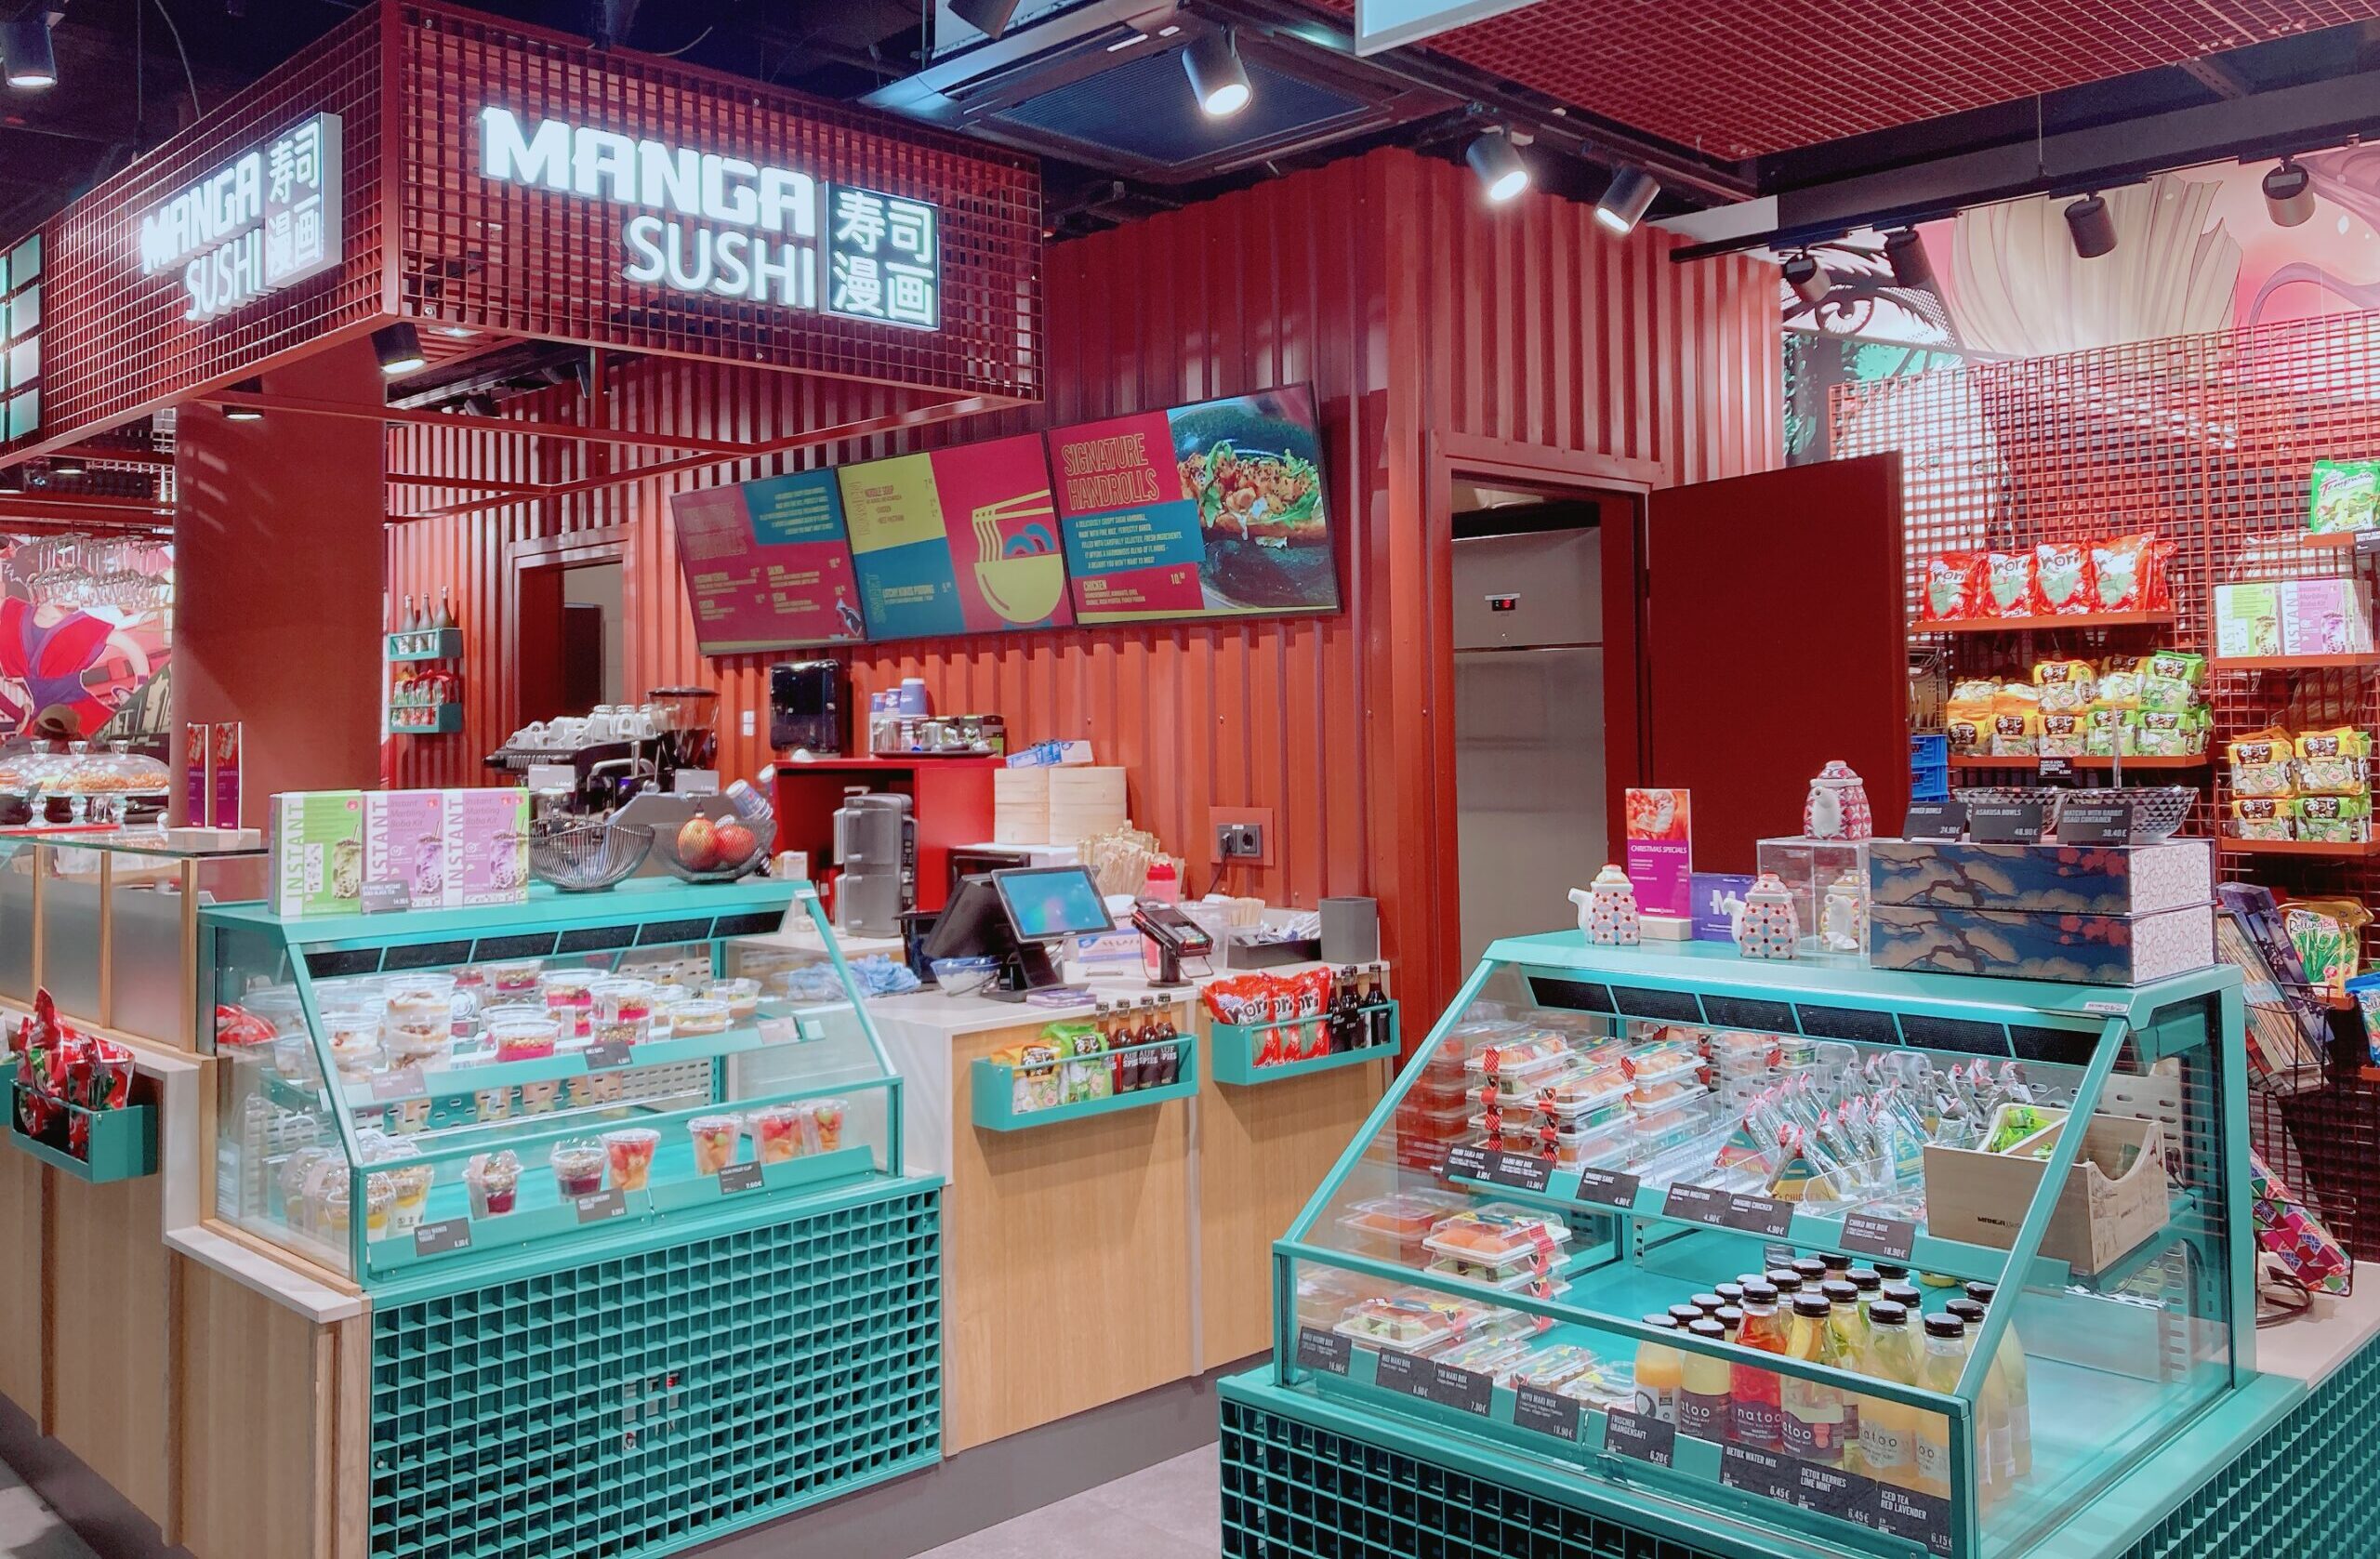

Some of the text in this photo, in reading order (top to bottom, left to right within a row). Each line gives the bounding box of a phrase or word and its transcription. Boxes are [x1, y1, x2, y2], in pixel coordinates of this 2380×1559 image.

[269, 122, 321, 204] 寿司
[481, 106, 816, 238] MANGA
[140, 152, 262, 275] MANGA
[838, 190, 932, 263] 寿司
[268, 193, 324, 279] 漫画
[626, 215, 815, 310] SUSHI
[185, 228, 263, 322] SUSHI
[833, 251, 935, 324] 漫画
[1062, 432, 1149, 477] SIGNATURE
[1066, 468, 1161, 511] HANDROLLS
[2285, 588, 2301, 655] INSTANT
[466, 808, 500, 816] Marbling
[2002, 808, 2022, 816] BOWLS
[2063, 809, 2087, 817] MATCHA
[2080, 815, 2112, 824] CONTAINER
[285, 802, 304, 899] INSTANT
[372, 800, 388, 883] NSTANT
[447, 799, 464, 891] INSTANT
[1631, 845, 1687, 854] CHRISTMAS SPECIALS
[2289, 918, 2323, 933] Rolling
[1601, 1173, 1615, 1183] SAKE
[1752, 1201, 1774, 1212] CHICKEN
[1703, 1213, 1720, 1224] 4.90€
[1865, 1221, 1876, 1230] MIX
[1876, 1222, 1889, 1233] BOX
[1765, 1224, 1785, 1235] 4.90€
[1883, 1246, 1907, 1259] 18.90€
[1390, 1355, 1402, 1367] MAKI
[1402, 1358, 1411, 1368] BOX
[1446, 1371, 1458, 1381] MAKI
[1458, 1374, 1468, 1384] BOX
[1533, 1394, 1546, 1406] MAKI
[1546, 1397, 1557, 1408] BOX
[1681, 1400, 1711, 1418] too
[1611, 1414, 1636, 1429] FRISCHER
[1738, 1407, 1782, 1423] natoo
[1609, 1423, 1647, 1440] ORANGENSAFT
[1782, 1420, 1812, 1440] atoo
[1649, 1450, 1670, 1465] 6.20€
[1726, 1446, 1778, 1469] DETOX WATER MIX
[1800, 1476, 1831, 1494] LIME MINT
[1801, 1467, 1847, 1487] DETOX BERRIES
[1769, 1485, 1791, 1500] 6.45€
[1881, 1489, 1910, 1506] ICED TEA
[1847, 1507, 1870, 1525] 6.45€
[1880, 1499, 1927, 1521] RED LAVENDER
[1931, 1531, 1952, 1549] 6.15€
